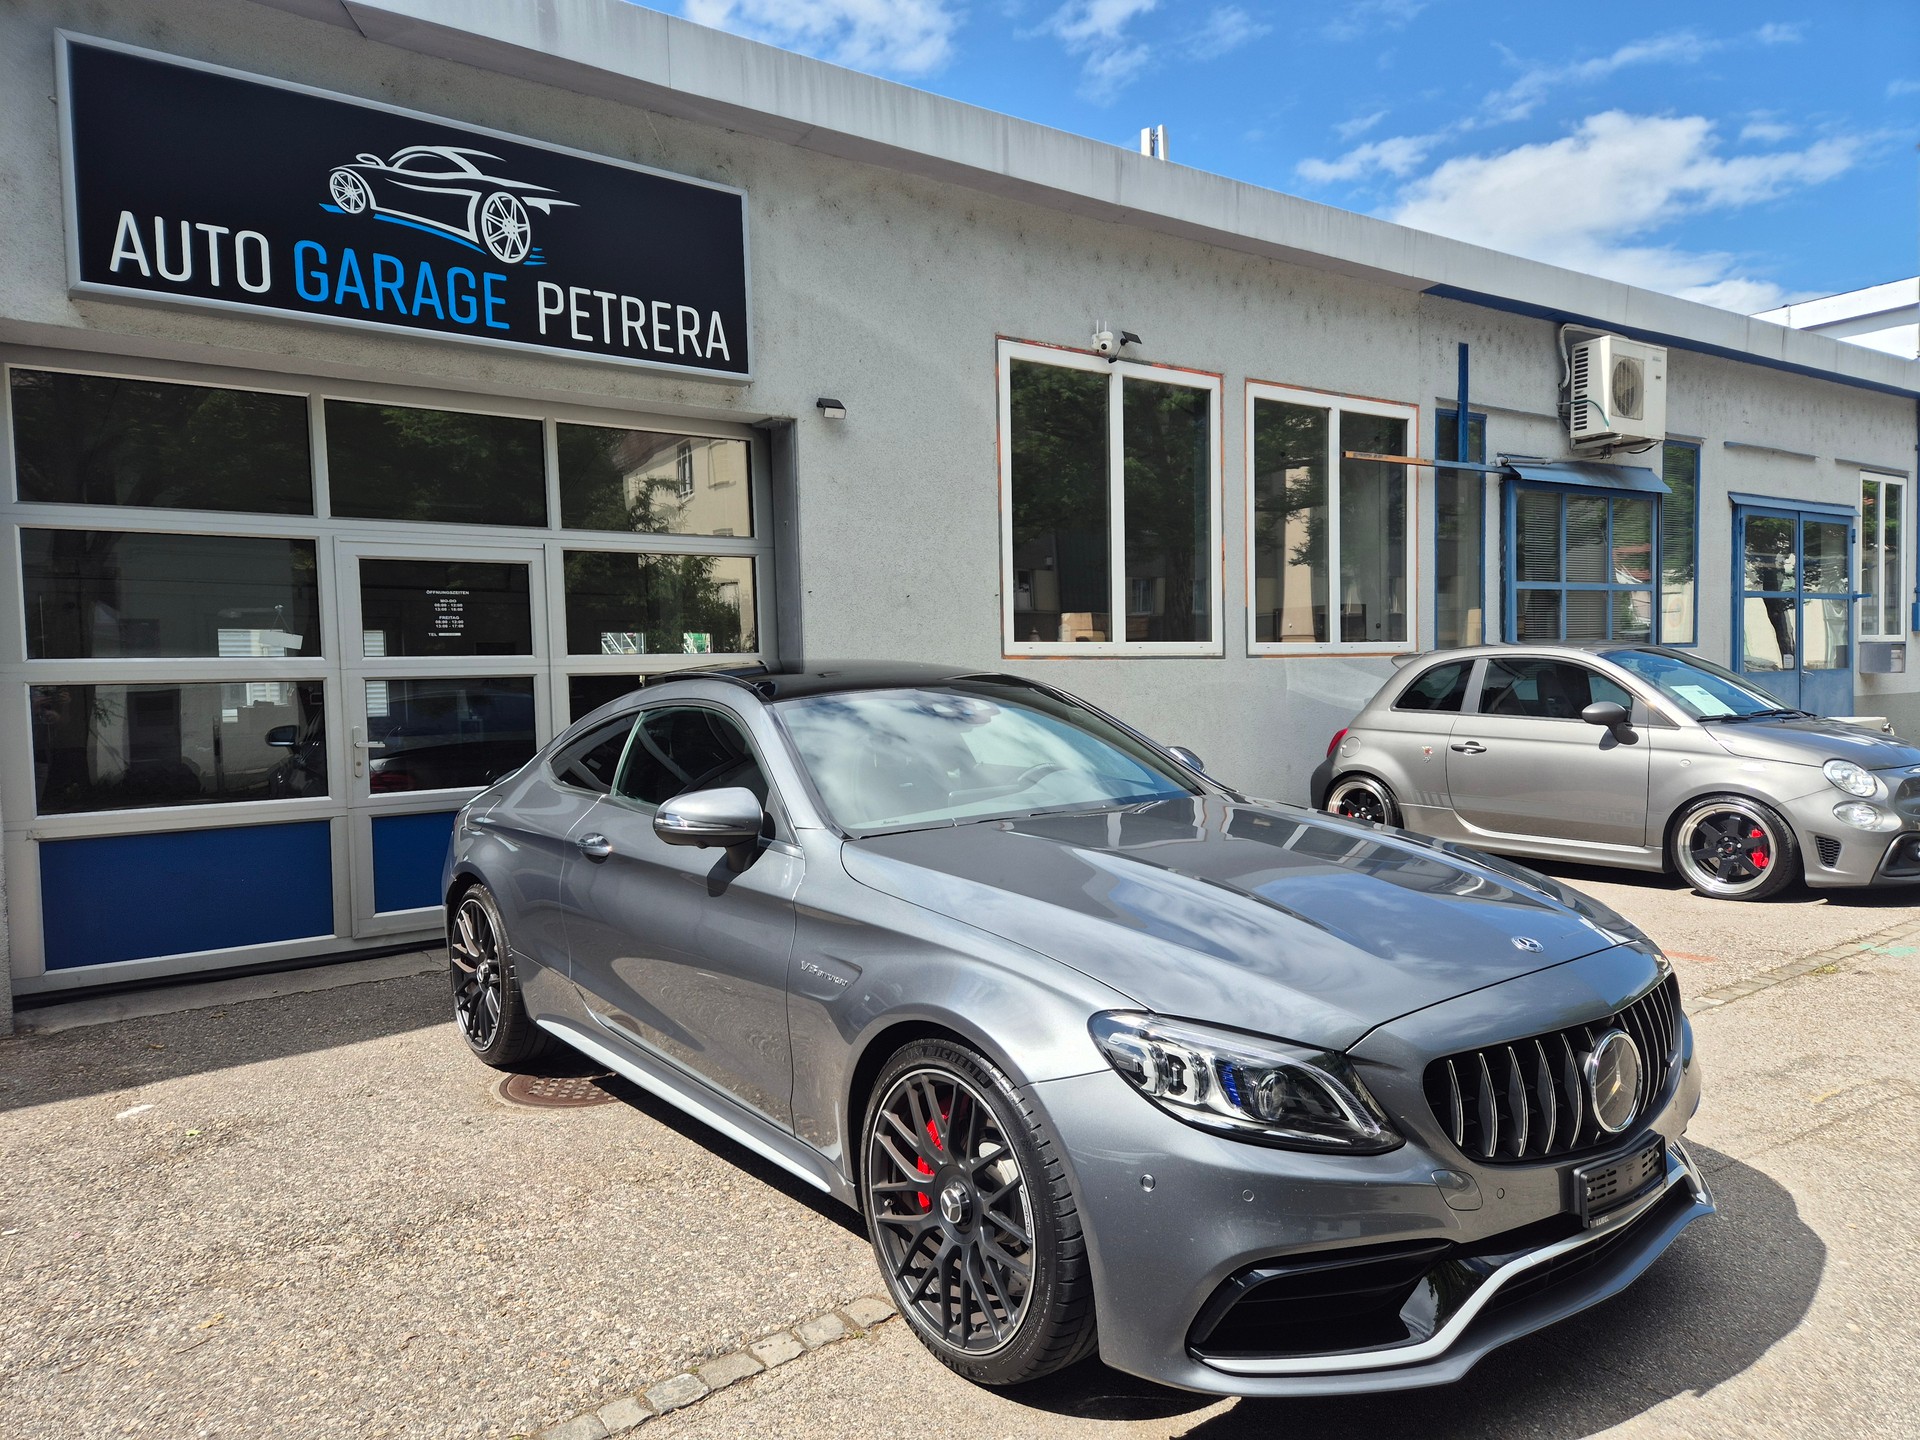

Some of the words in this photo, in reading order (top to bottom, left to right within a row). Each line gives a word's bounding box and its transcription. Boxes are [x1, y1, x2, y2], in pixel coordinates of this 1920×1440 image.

[109, 210, 271, 294] AUTO
[293, 239, 510, 331] GARAGE
[537, 280, 731, 362] PETRERA
[924, 1046, 991, 1087] MICHELIN
